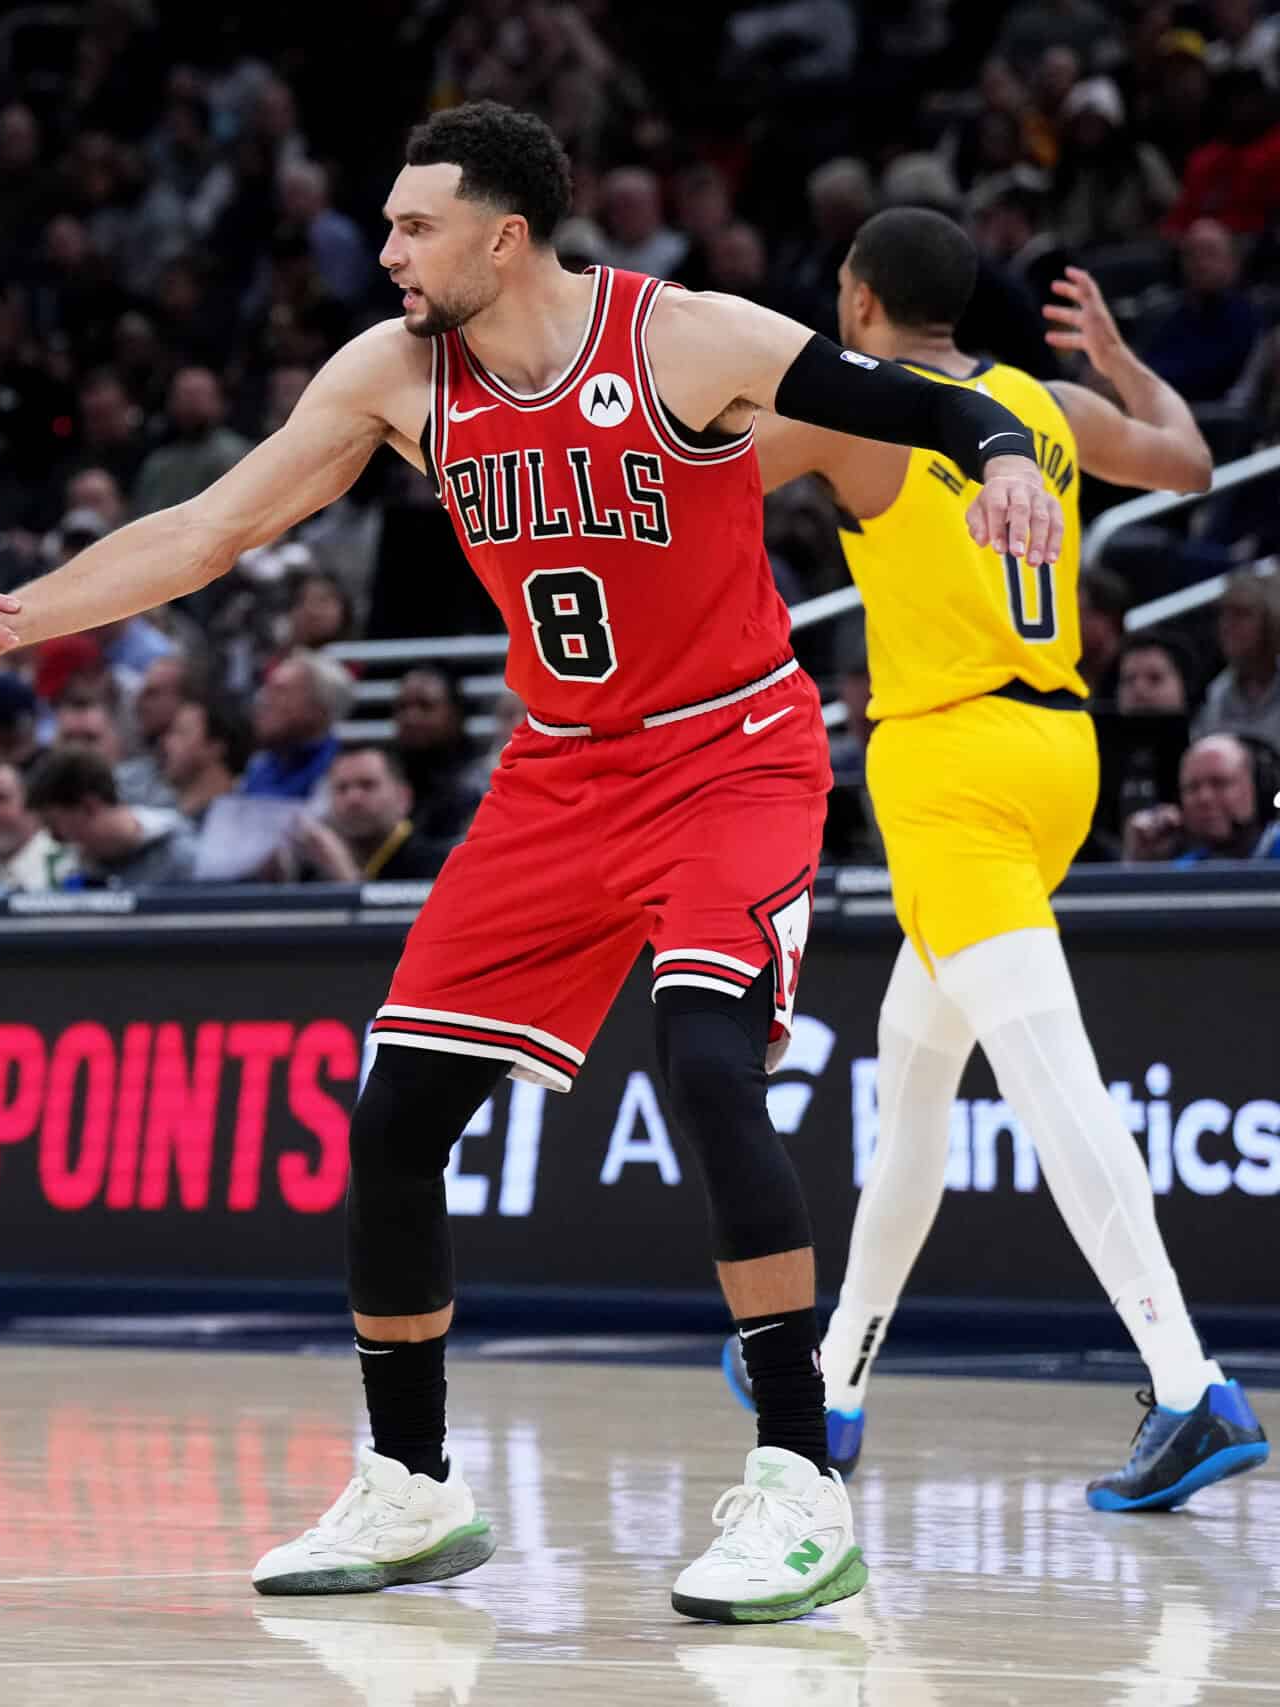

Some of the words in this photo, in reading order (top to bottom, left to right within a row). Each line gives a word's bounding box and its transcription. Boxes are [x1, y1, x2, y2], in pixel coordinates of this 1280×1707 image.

[443, 447, 672, 547] BULLS
[521, 566, 619, 684] 8
[599, 1071, 682, 1185] A
